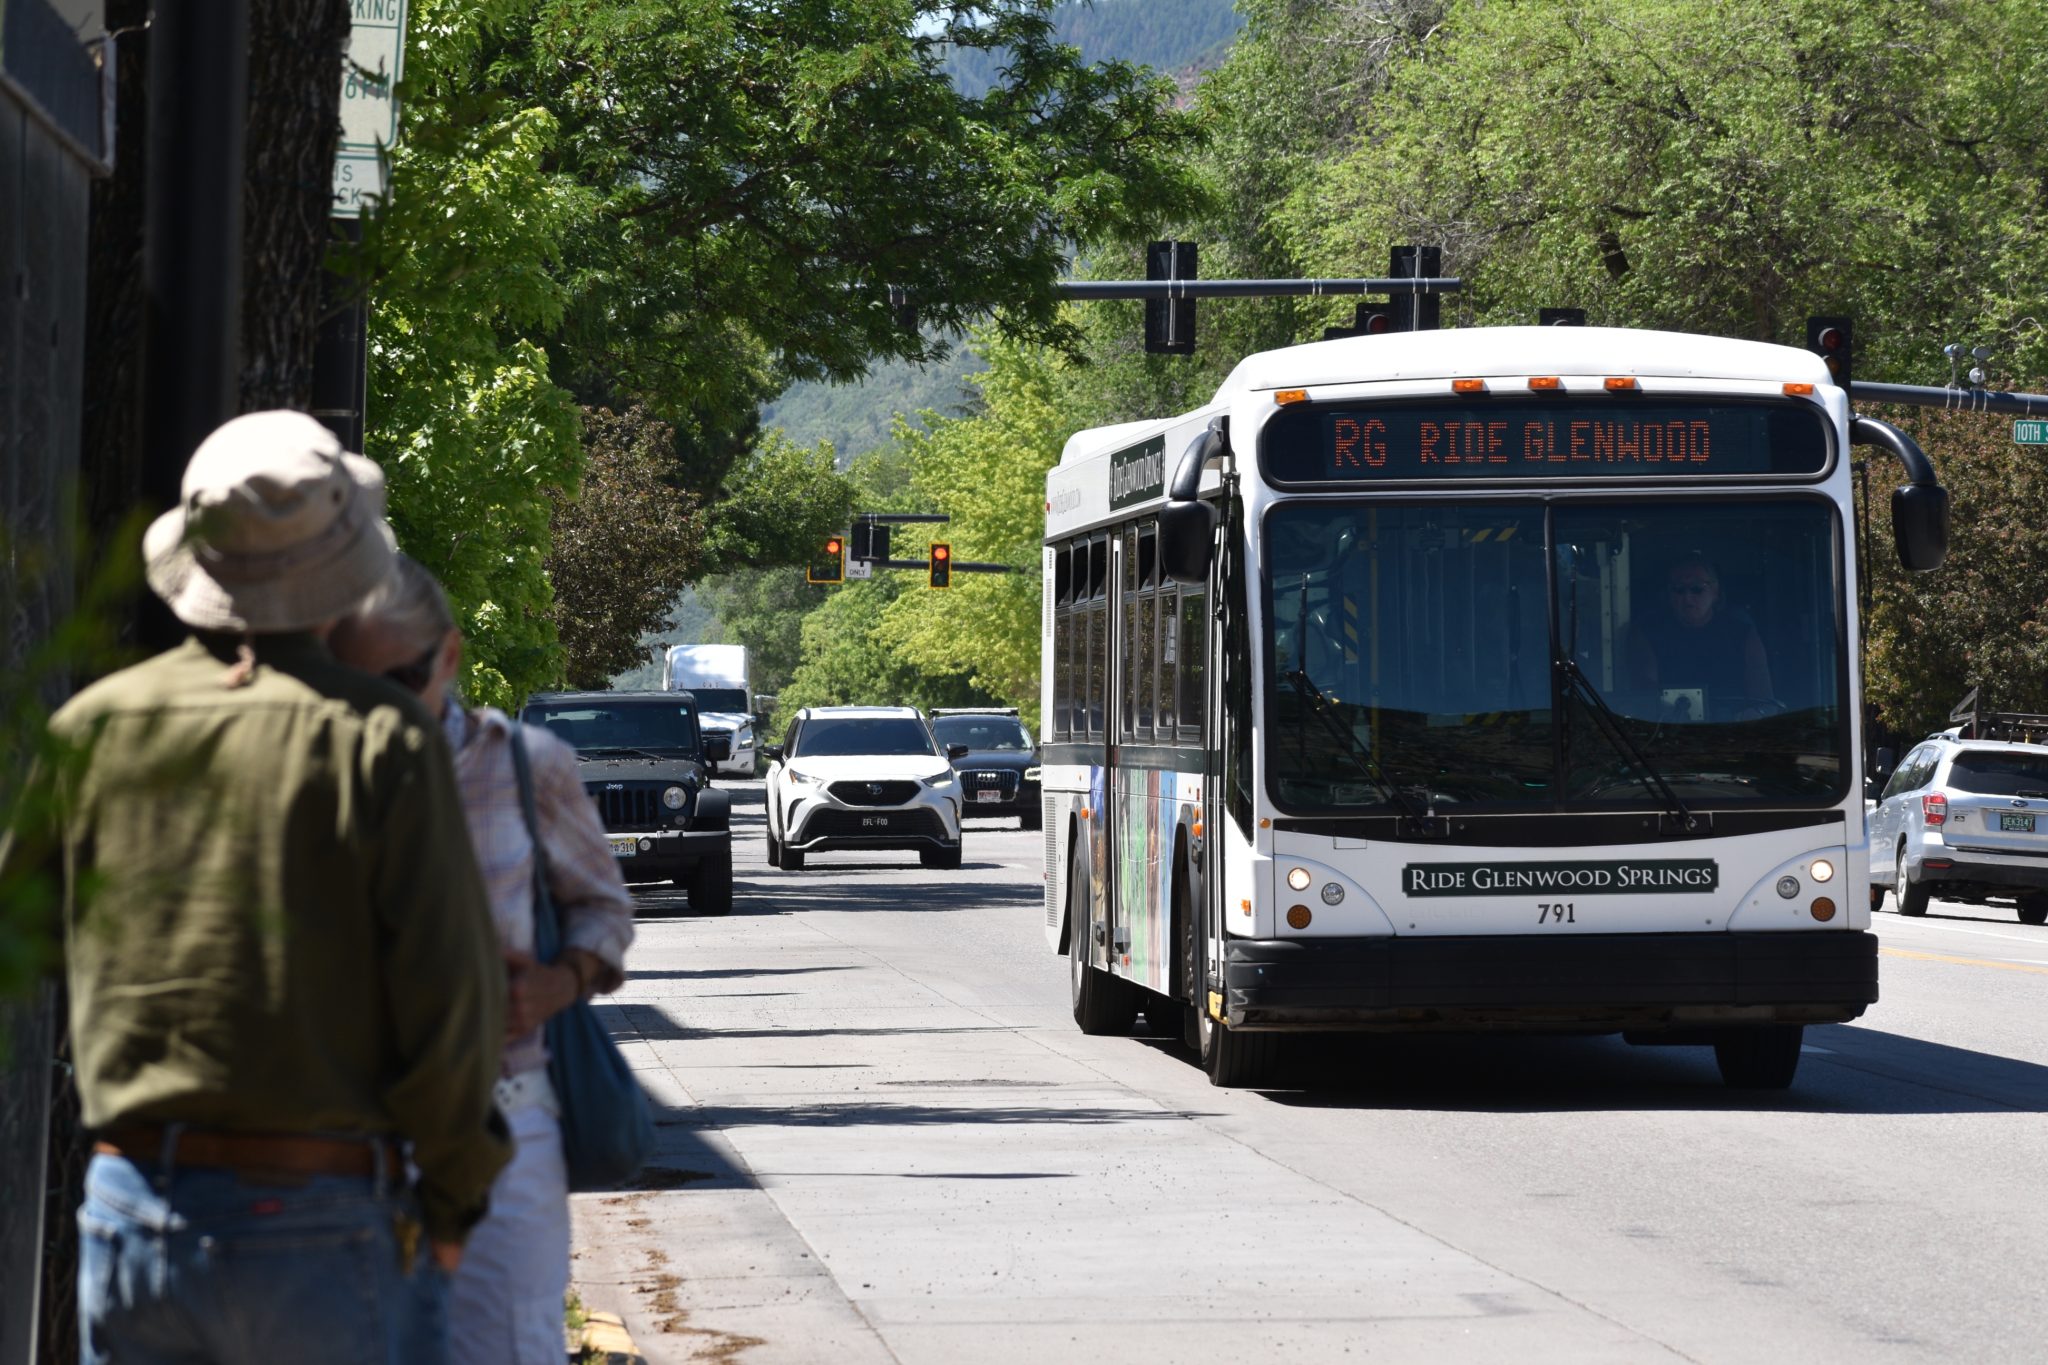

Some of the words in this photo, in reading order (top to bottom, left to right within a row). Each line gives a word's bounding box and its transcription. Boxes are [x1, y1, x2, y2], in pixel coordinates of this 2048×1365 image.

[349, 0, 396, 21] KING
[1335, 418, 1387, 466] RG
[1420, 421, 1508, 463] RIDE
[1523, 421, 1710, 463] GLENWOOD
[2017, 423, 2041, 441] 10TH
[849, 568, 866, 576] ONLY
[606, 782, 624, 791] Jeep
[1411, 869, 1465, 890] RIDE
[1472, 868, 1611, 889] GLENWOOD
[1617, 866, 1712, 887] SPRINGS
[1538, 903, 1575, 924] 791
